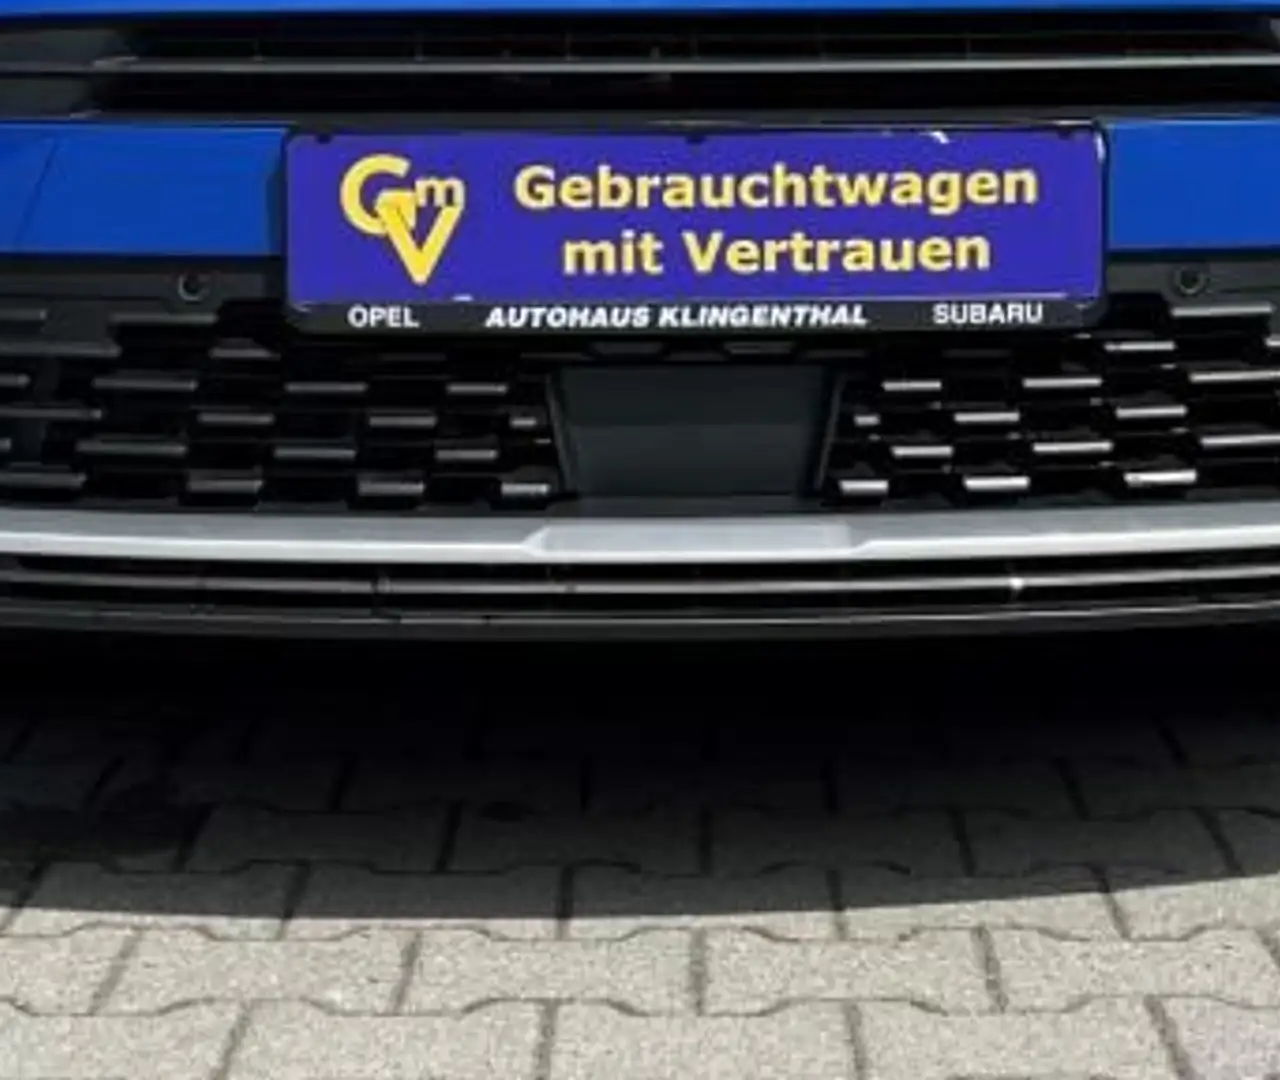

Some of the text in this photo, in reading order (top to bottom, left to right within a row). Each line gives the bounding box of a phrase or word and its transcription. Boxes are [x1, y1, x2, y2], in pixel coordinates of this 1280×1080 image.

[514, 161, 1038, 216] Gebrauchtwagen
[562, 229, 991, 275] mit Vertrauen
[347, 304, 420, 328] OPEL
[484, 304, 869, 329] AUTOHAUS KLINGENTHAL
[932, 302, 1044, 325] SUBARU
